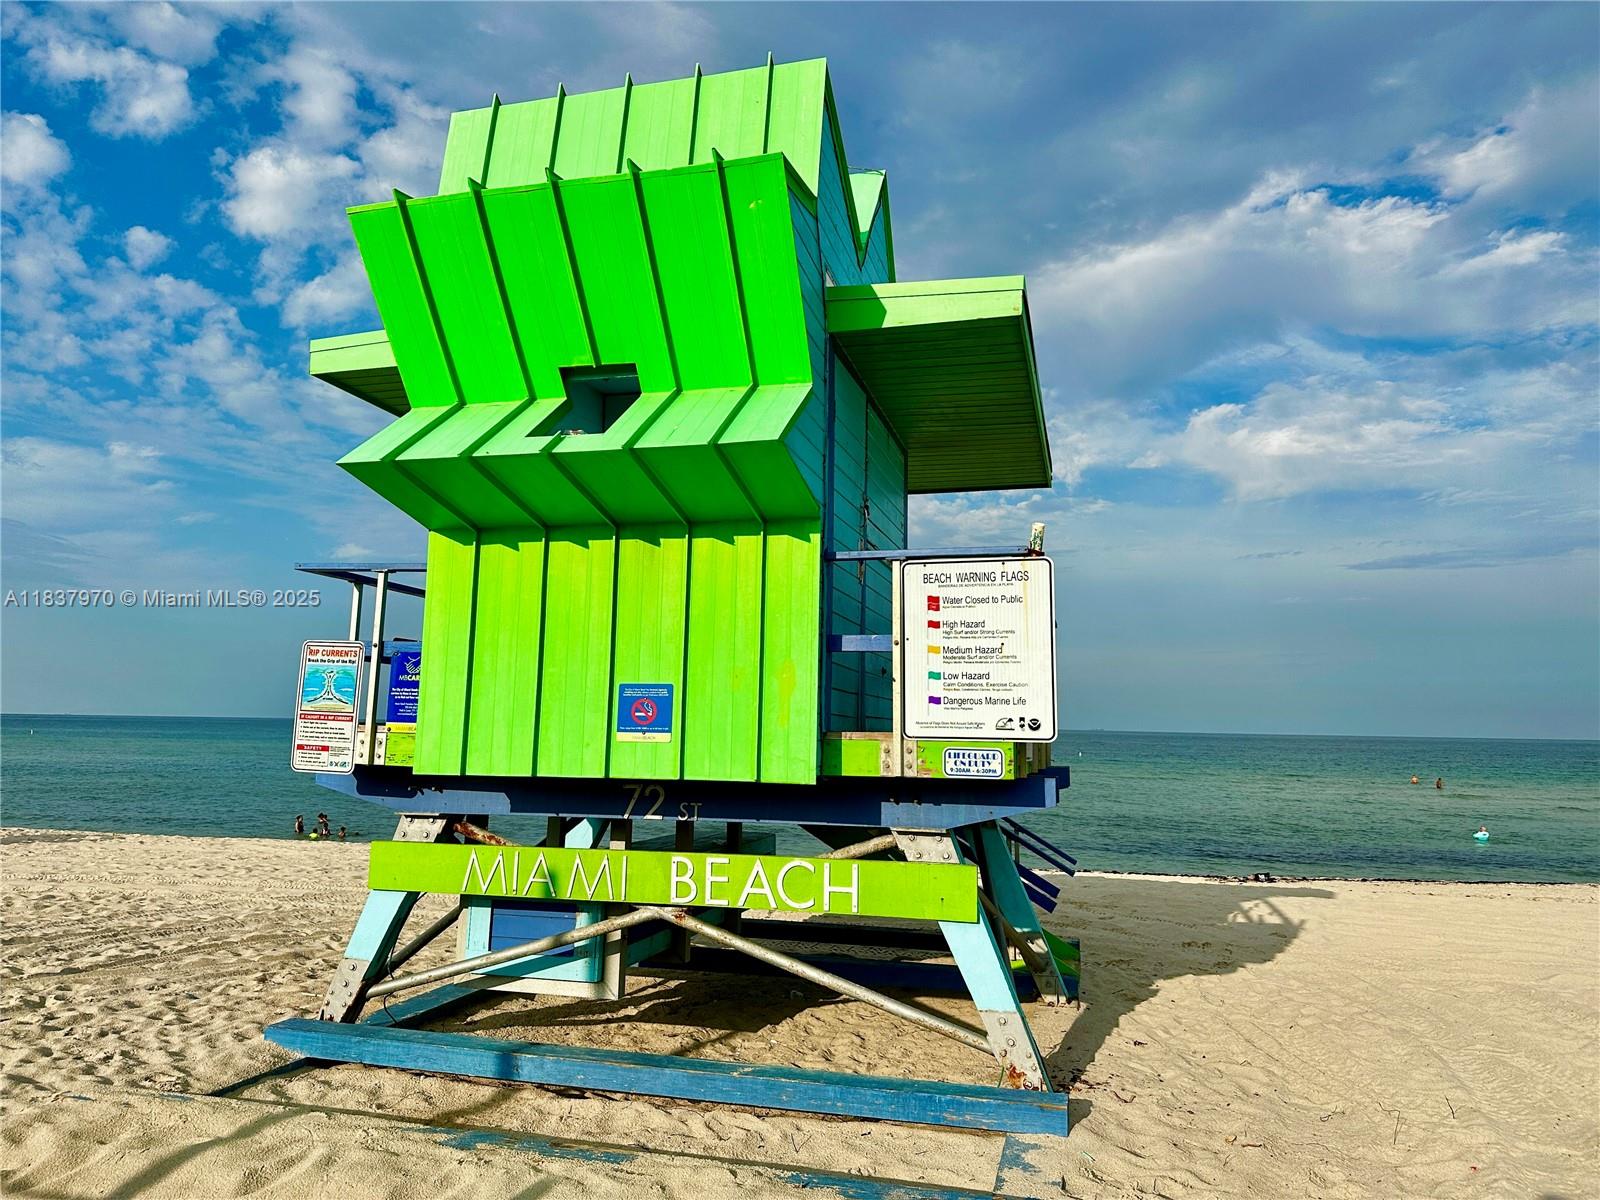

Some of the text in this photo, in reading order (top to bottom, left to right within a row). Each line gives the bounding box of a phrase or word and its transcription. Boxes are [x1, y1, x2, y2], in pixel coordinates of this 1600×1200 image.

[923, 570, 1029, 584] BEACH WARNING FLAGS
[942, 594, 1024, 604] Water Closed to Public
[942, 620, 986, 630] High Hazard
[308, 648, 358, 657] RIP CURRENTS
[942, 646, 1003, 654] Medium Hazard
[942, 672, 990, 680] Low Hazard
[943, 696, 1026, 706] Dangerous Marine Life
[948, 752, 999, 760] LIFEGUARD
[623, 784, 702, 821] 72 ST
[461, 847, 860, 914] MIAMI BEACH
